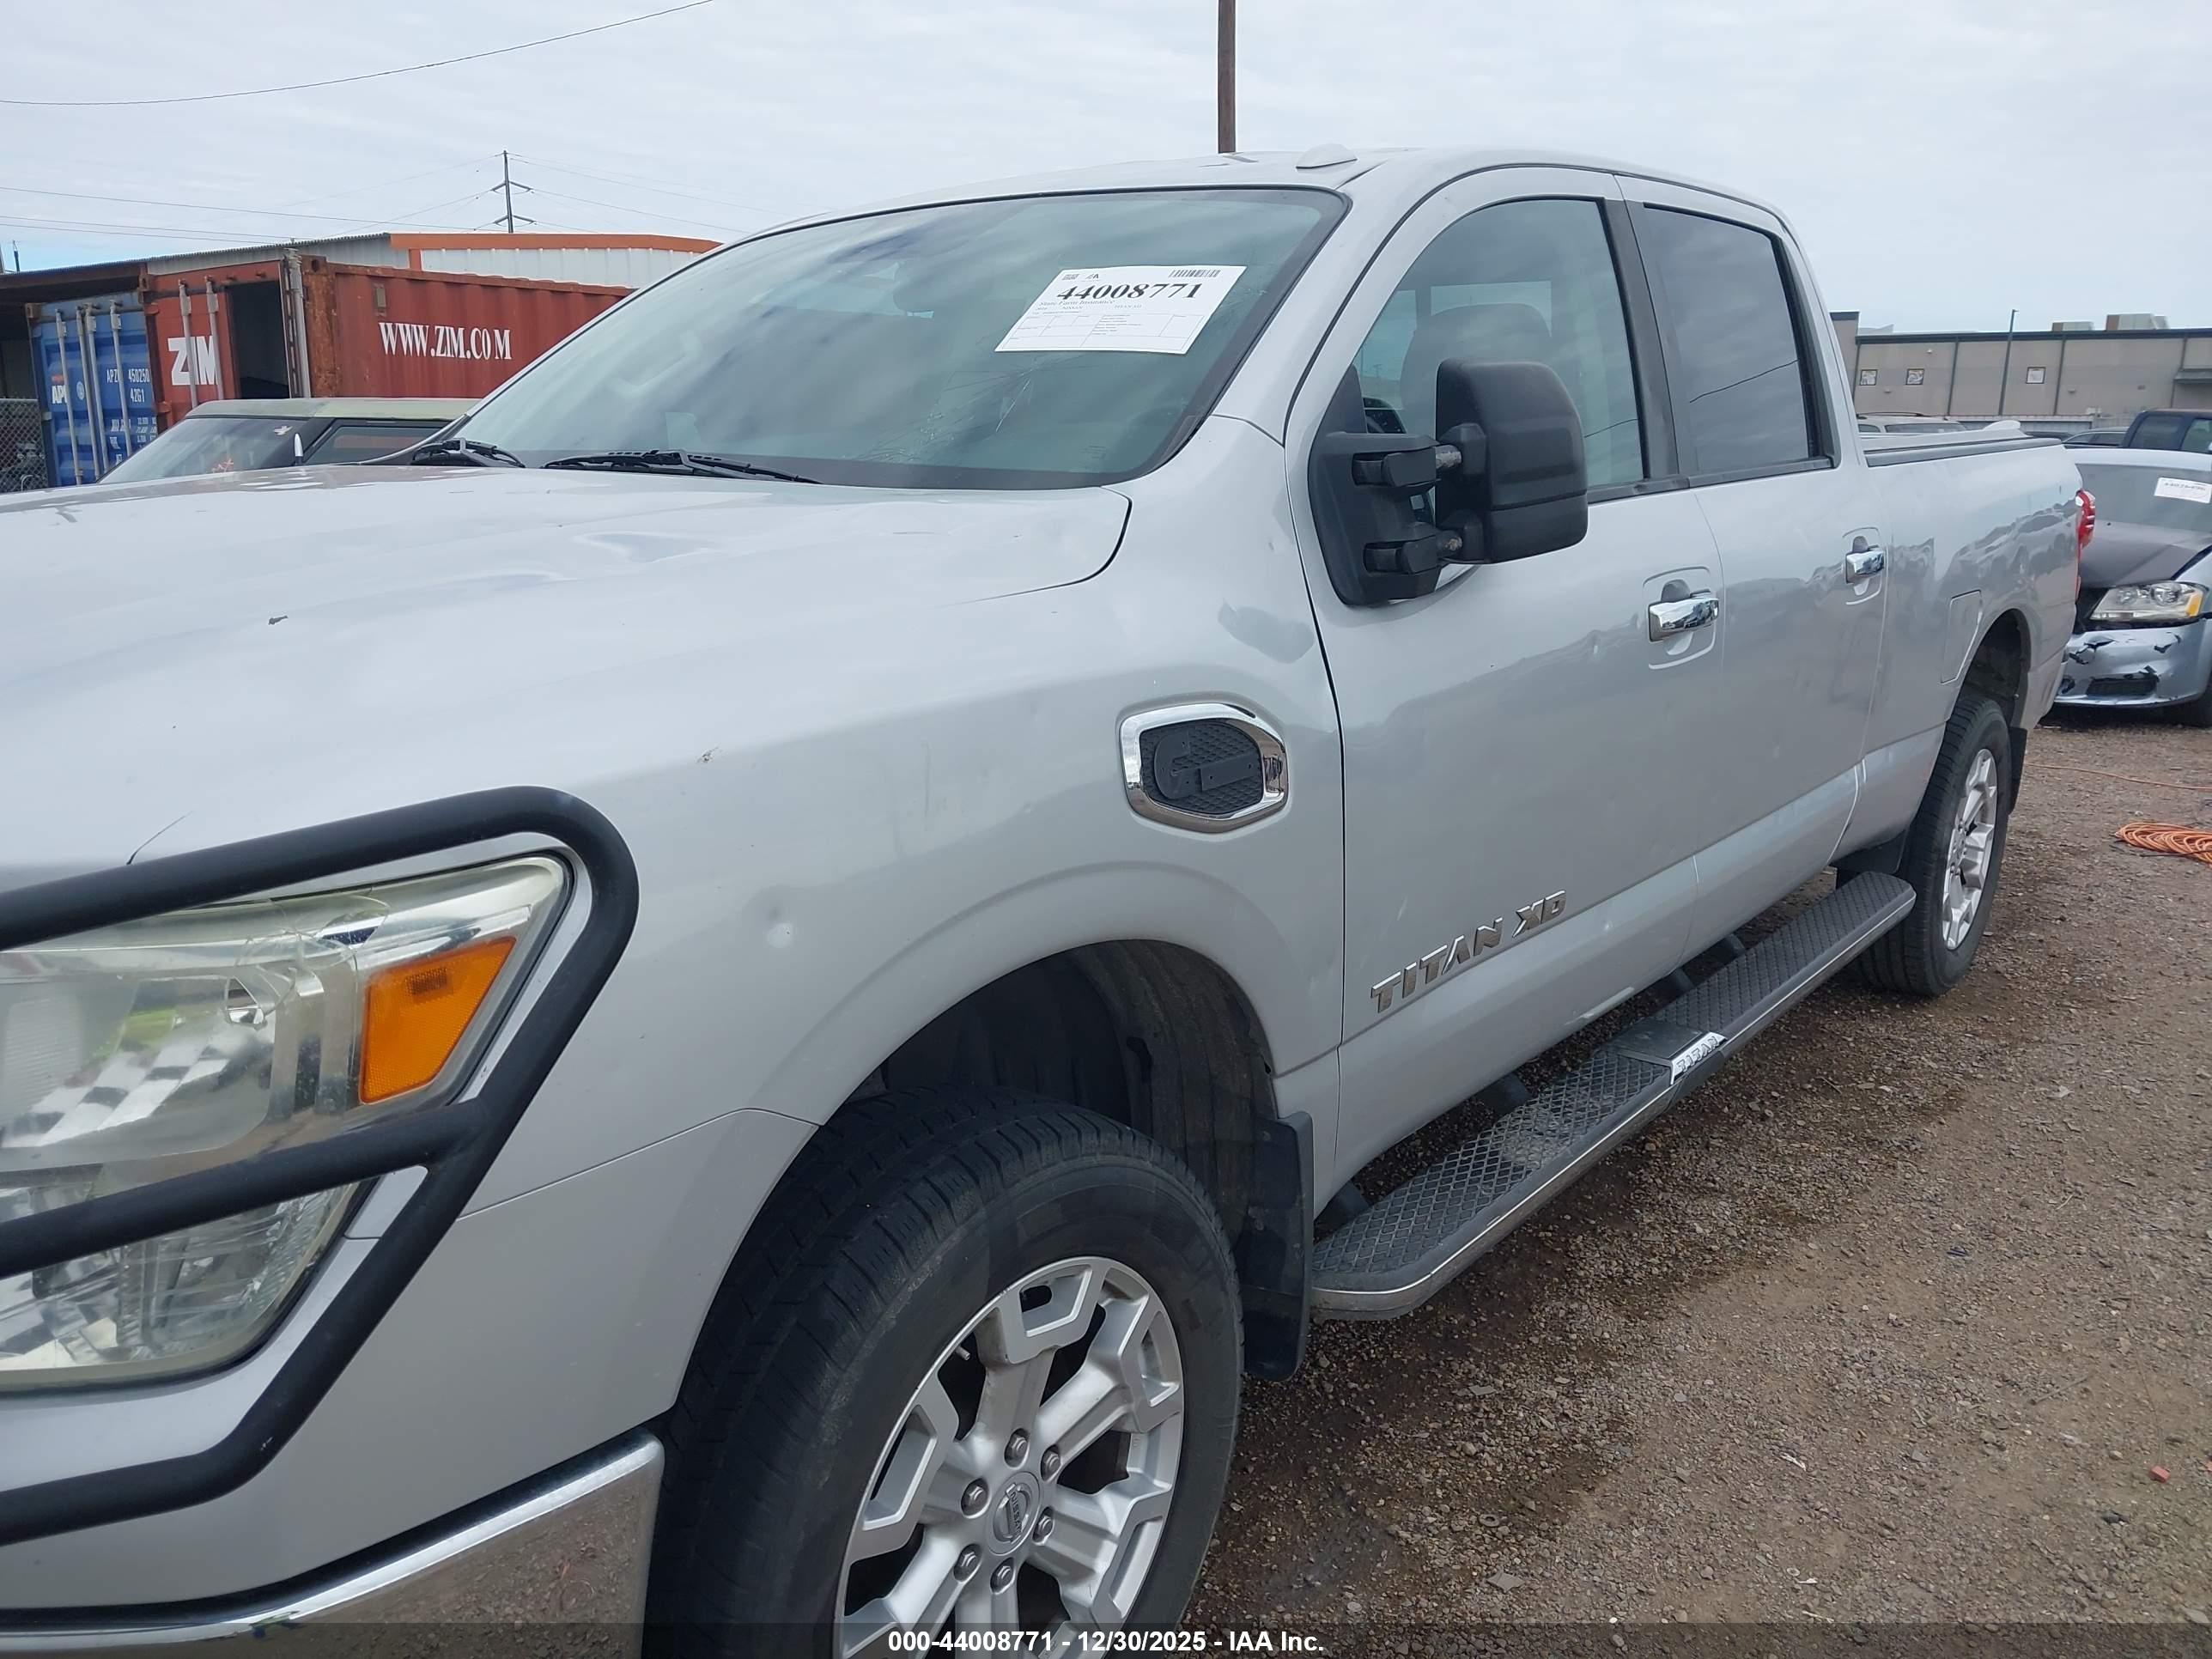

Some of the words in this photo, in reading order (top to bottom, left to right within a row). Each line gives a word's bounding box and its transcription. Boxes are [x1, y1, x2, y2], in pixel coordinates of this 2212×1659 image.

[1057, 283, 1202, 301] 44008771
[167, 336, 219, 386] ZIM
[1370, 916, 1503, 1013] TITAN
[1512, 890, 1567, 939] XD
[1676, 1036, 1718, 1072] TITAN
